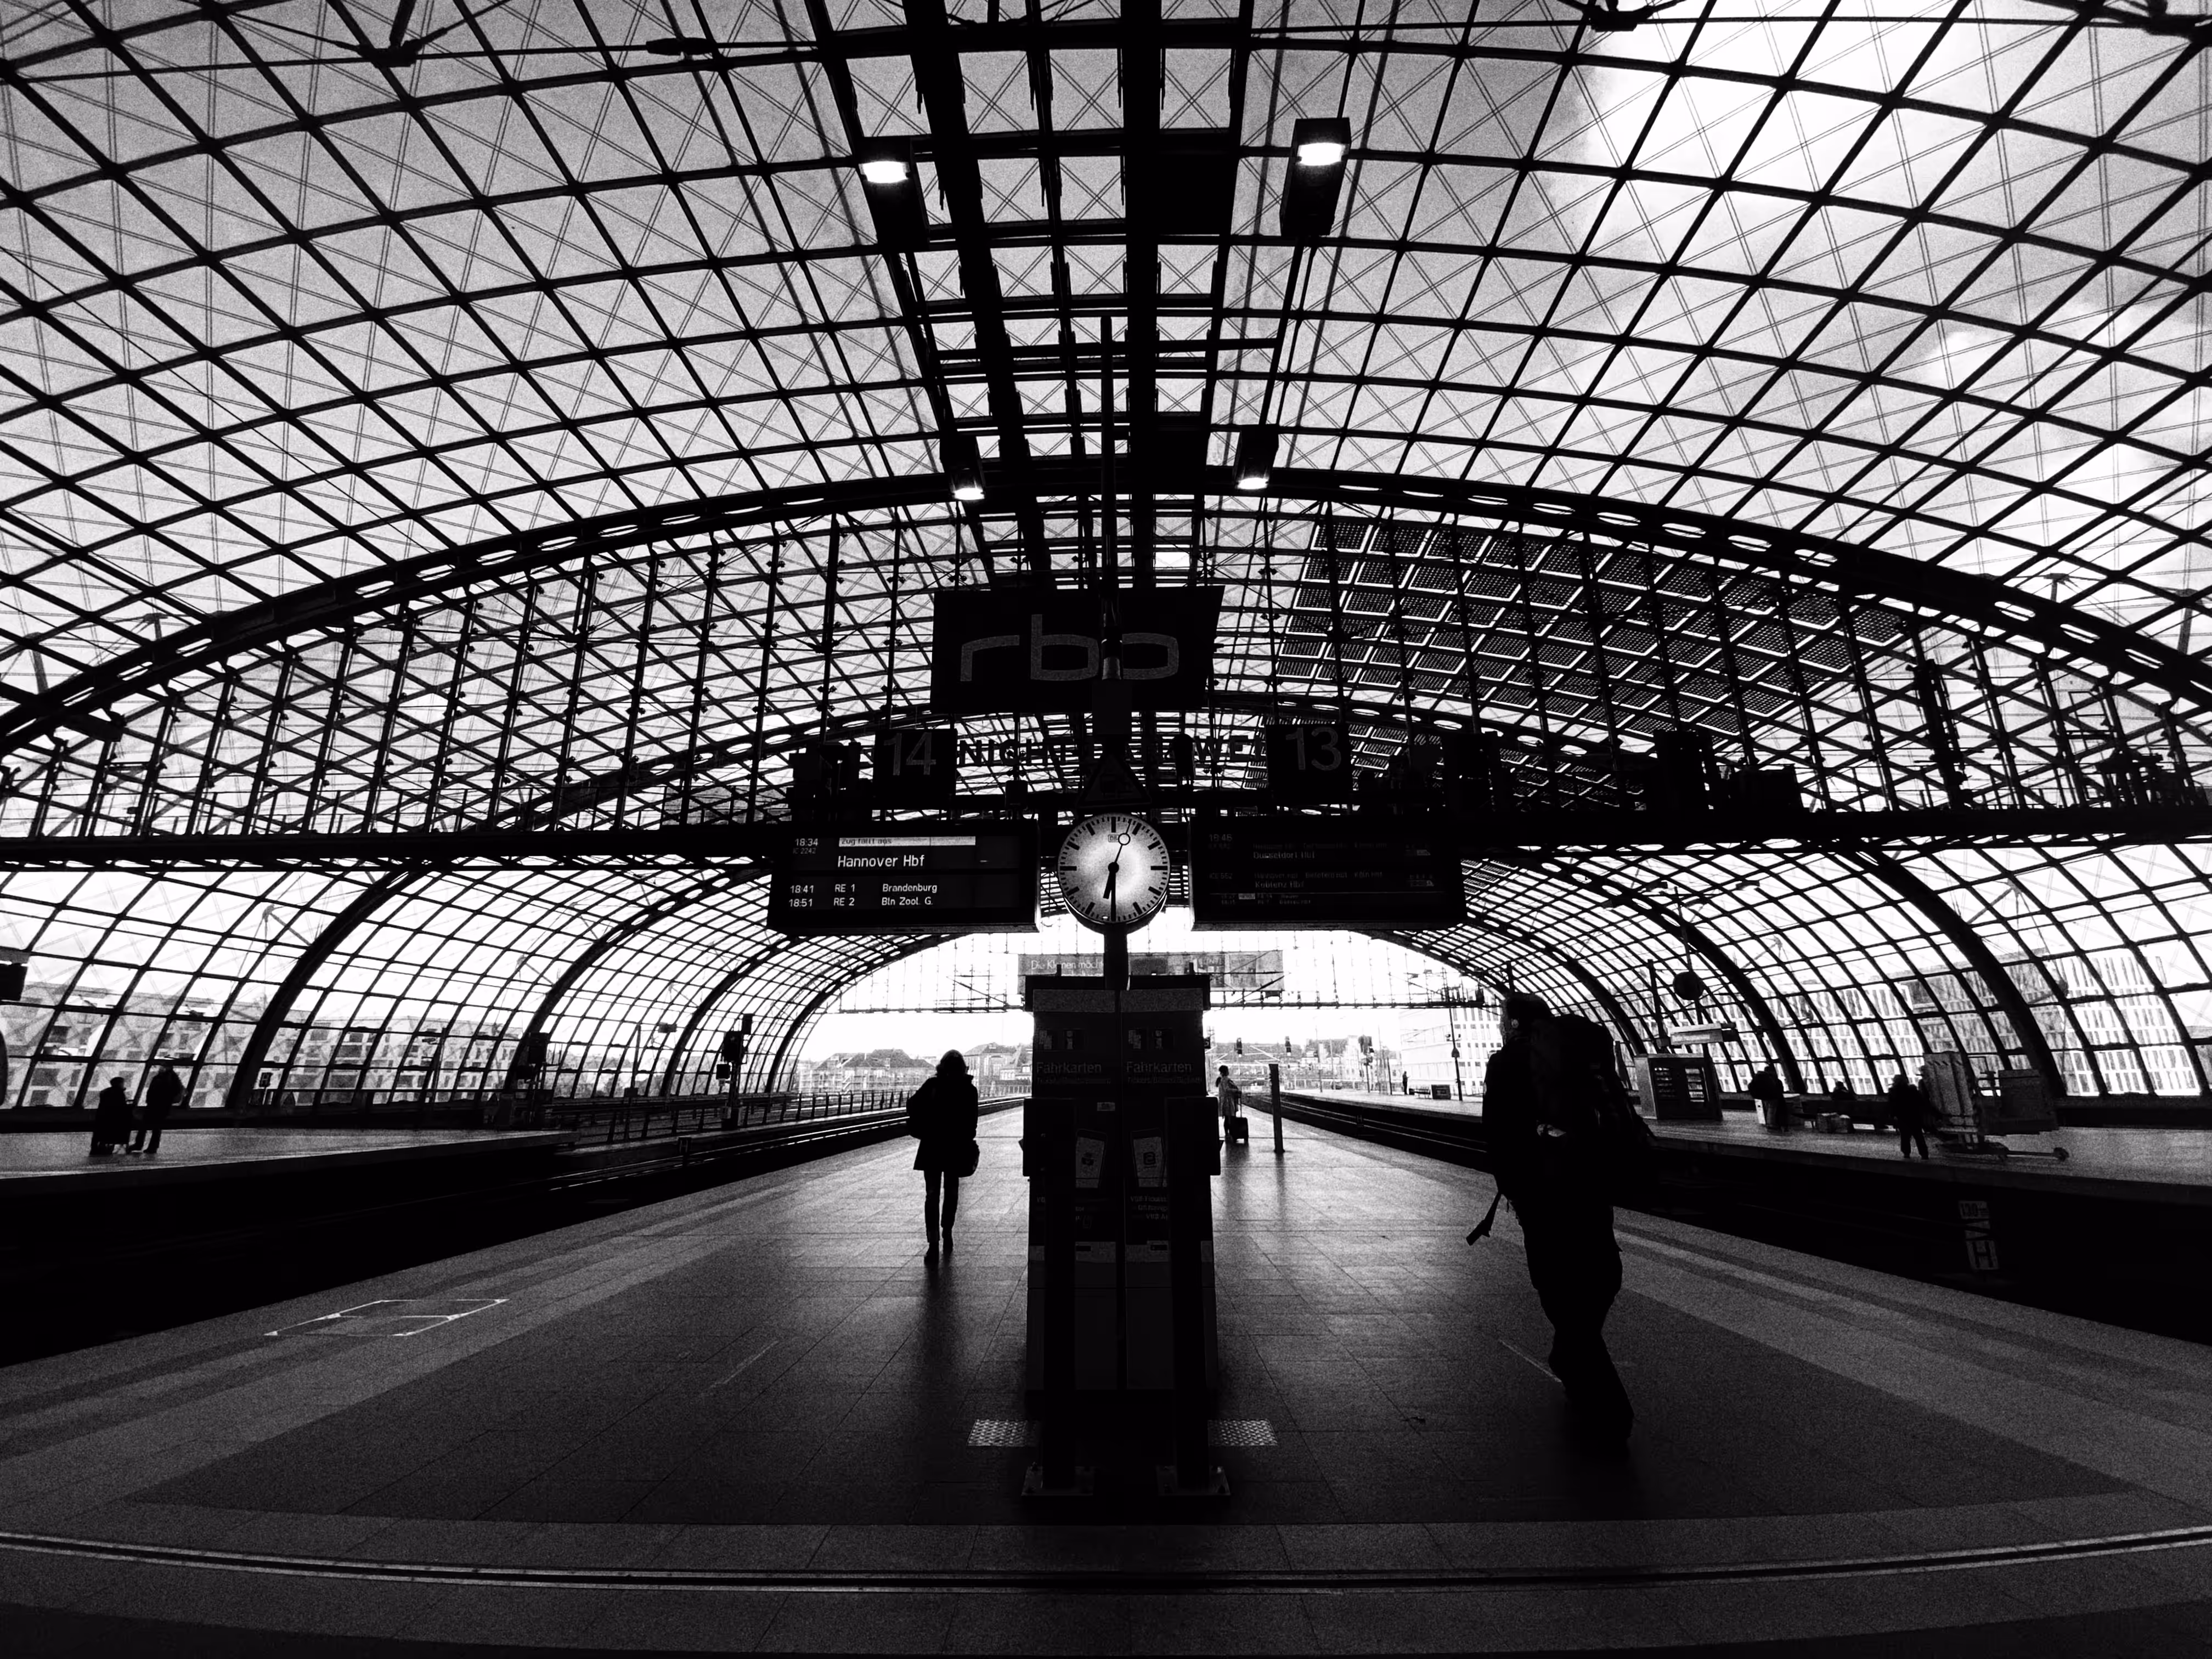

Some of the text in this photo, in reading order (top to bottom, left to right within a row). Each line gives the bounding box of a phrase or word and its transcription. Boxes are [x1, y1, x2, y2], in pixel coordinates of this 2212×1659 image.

[883, 732, 936, 776] 14
[1285, 726, 1342, 771] 13
[794, 838, 819, 847] 18:34
[837, 854, 925, 868] Hannover Hbf
[789, 883, 938, 894] 18:41 RE 1 Brandenburg
[788, 898, 813, 907] 18:51
[833, 897, 845, 906] RE
[848, 897, 855, 906] 2
[881, 896, 896, 906] Bln
[1047, 960, 1076, 969] Klnen
[1036, 1062, 1102, 1074] Fahrkarten
[1126, 1061, 1192, 1074] Fahrkarten
[1972, 1241, 1995, 1268] H
